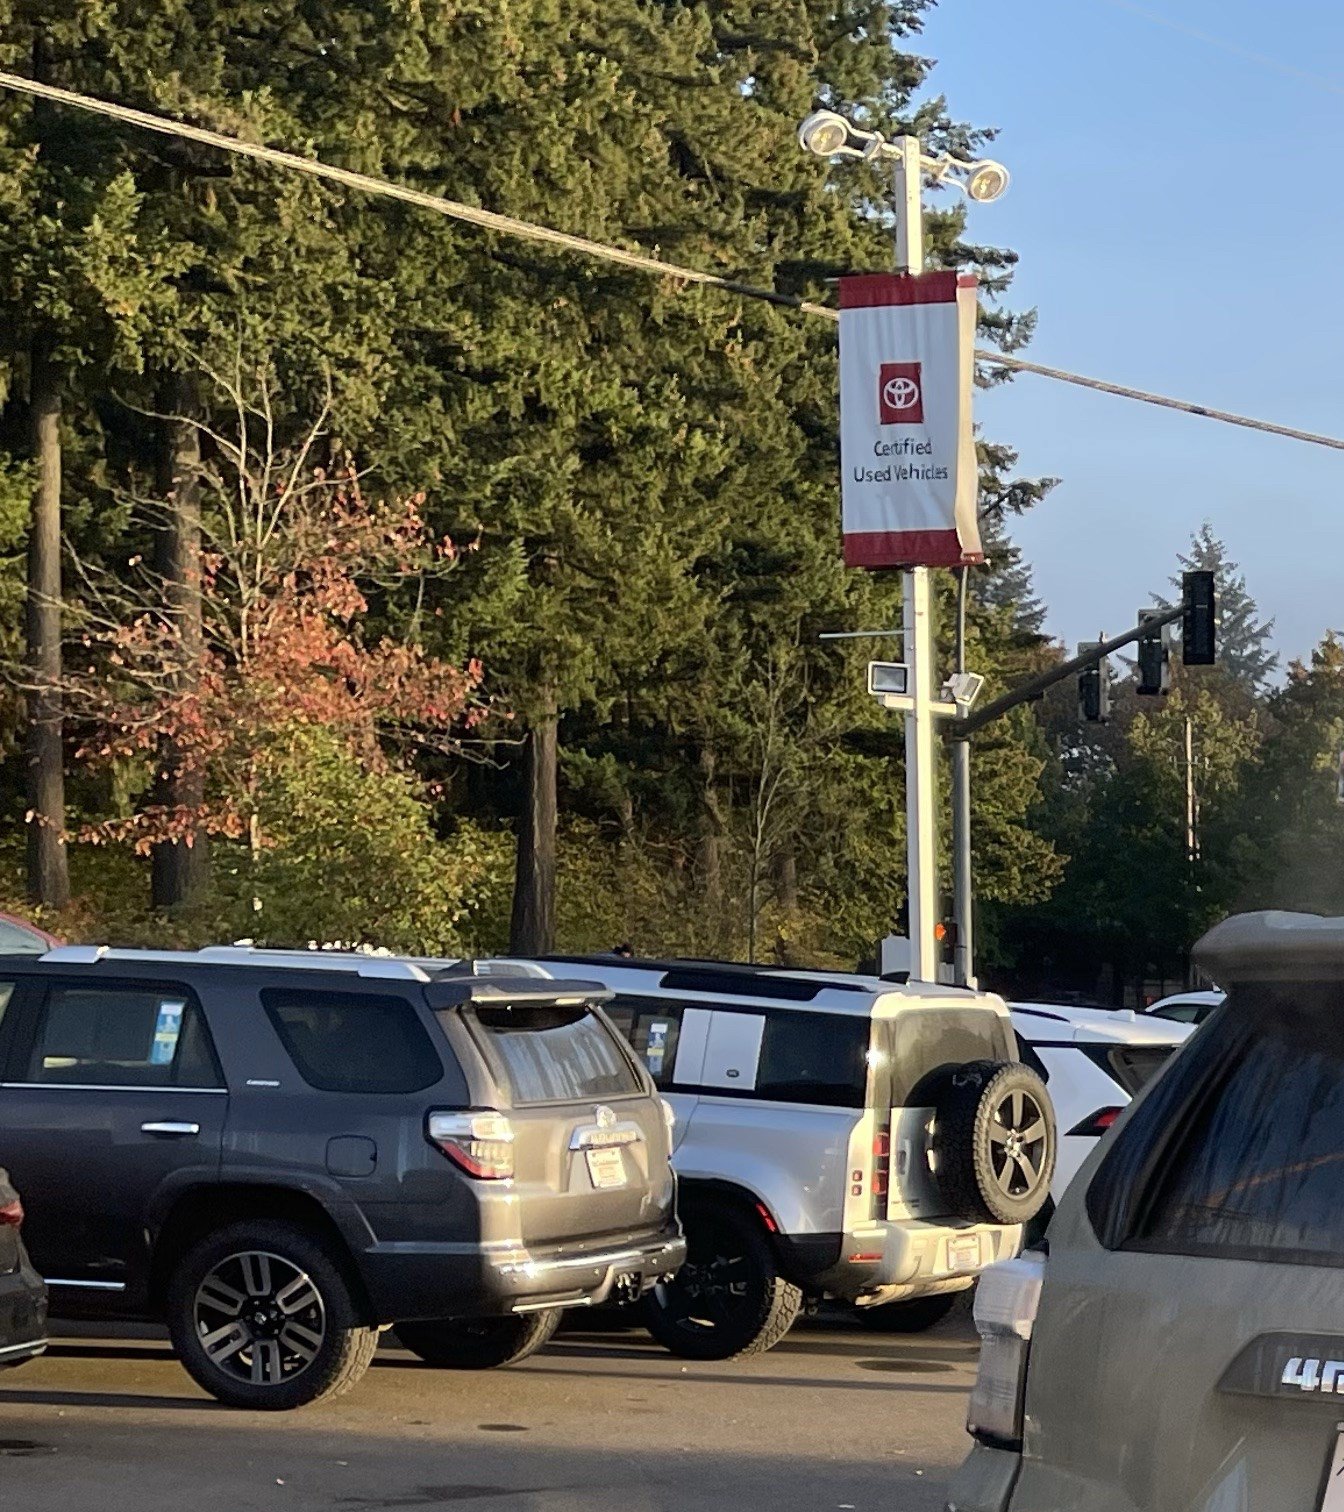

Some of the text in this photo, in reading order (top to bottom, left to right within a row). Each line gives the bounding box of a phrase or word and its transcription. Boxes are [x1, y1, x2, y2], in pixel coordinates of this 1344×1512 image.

[873, 437, 933, 457] Certified
[854, 463, 948, 483] Used Vehicles
